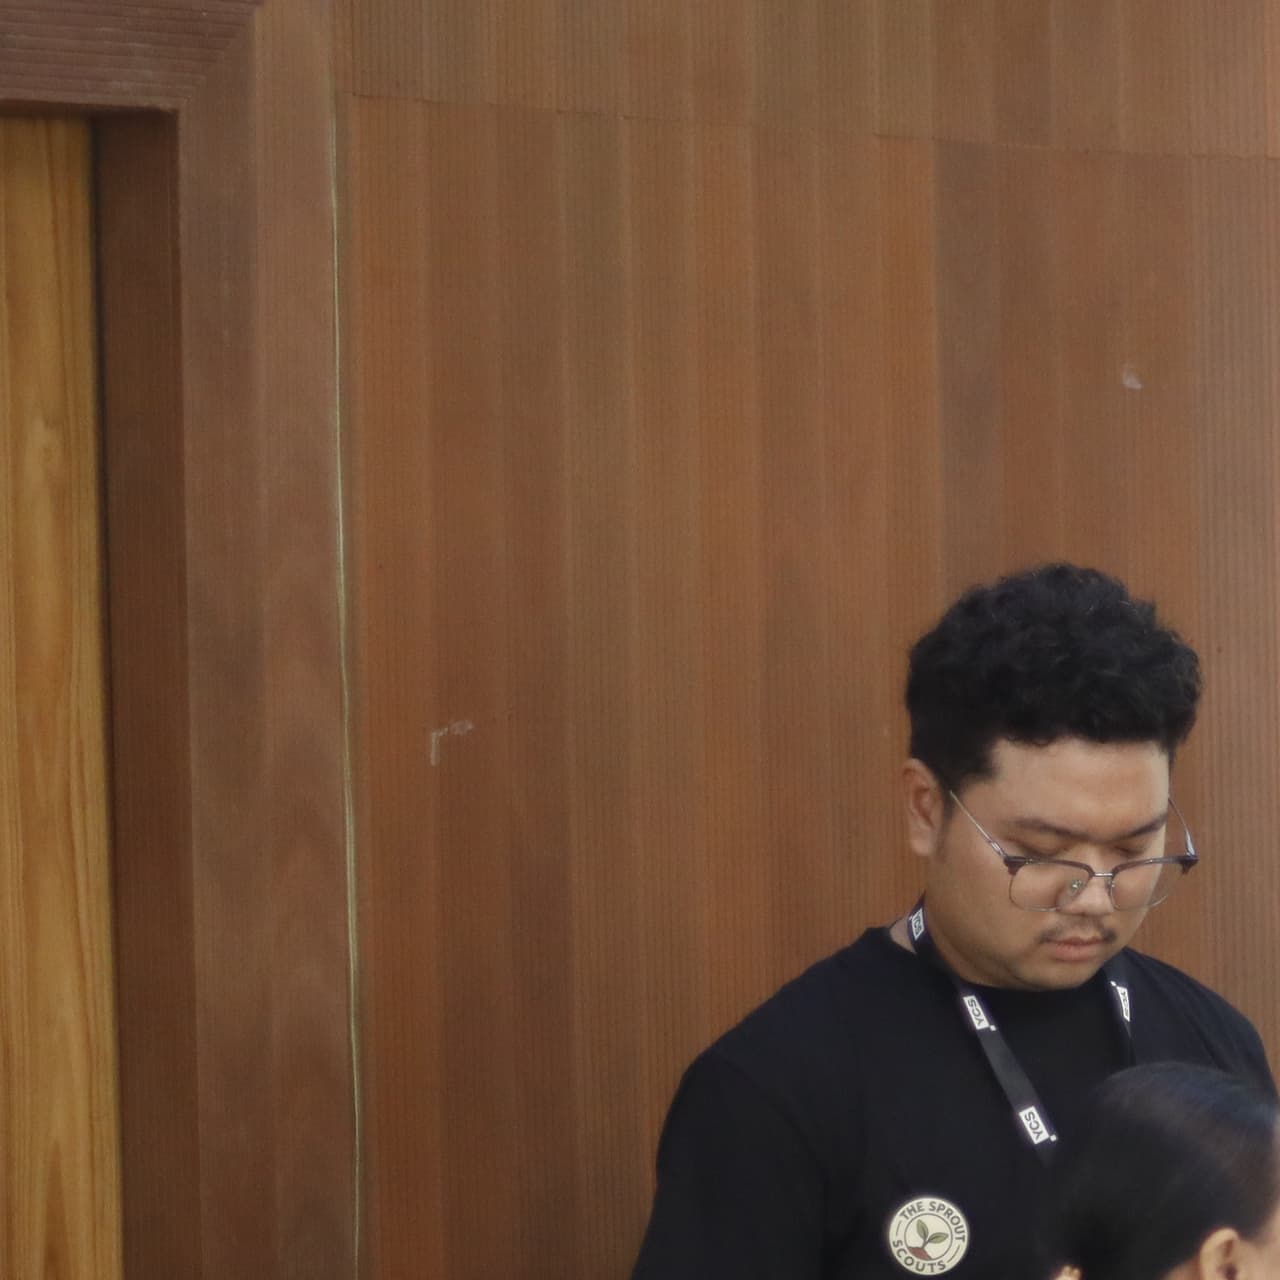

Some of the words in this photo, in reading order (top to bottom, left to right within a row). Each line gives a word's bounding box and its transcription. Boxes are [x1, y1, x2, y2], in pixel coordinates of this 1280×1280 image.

[967, 998, 985, 1026] YCS
[1024, 1111, 1043, 1141] YCS
[899, 1201, 925, 1220] THE
[928, 1201, 966, 1243] SPROUT
[892, 1239, 947, 1273] SCOUTS
